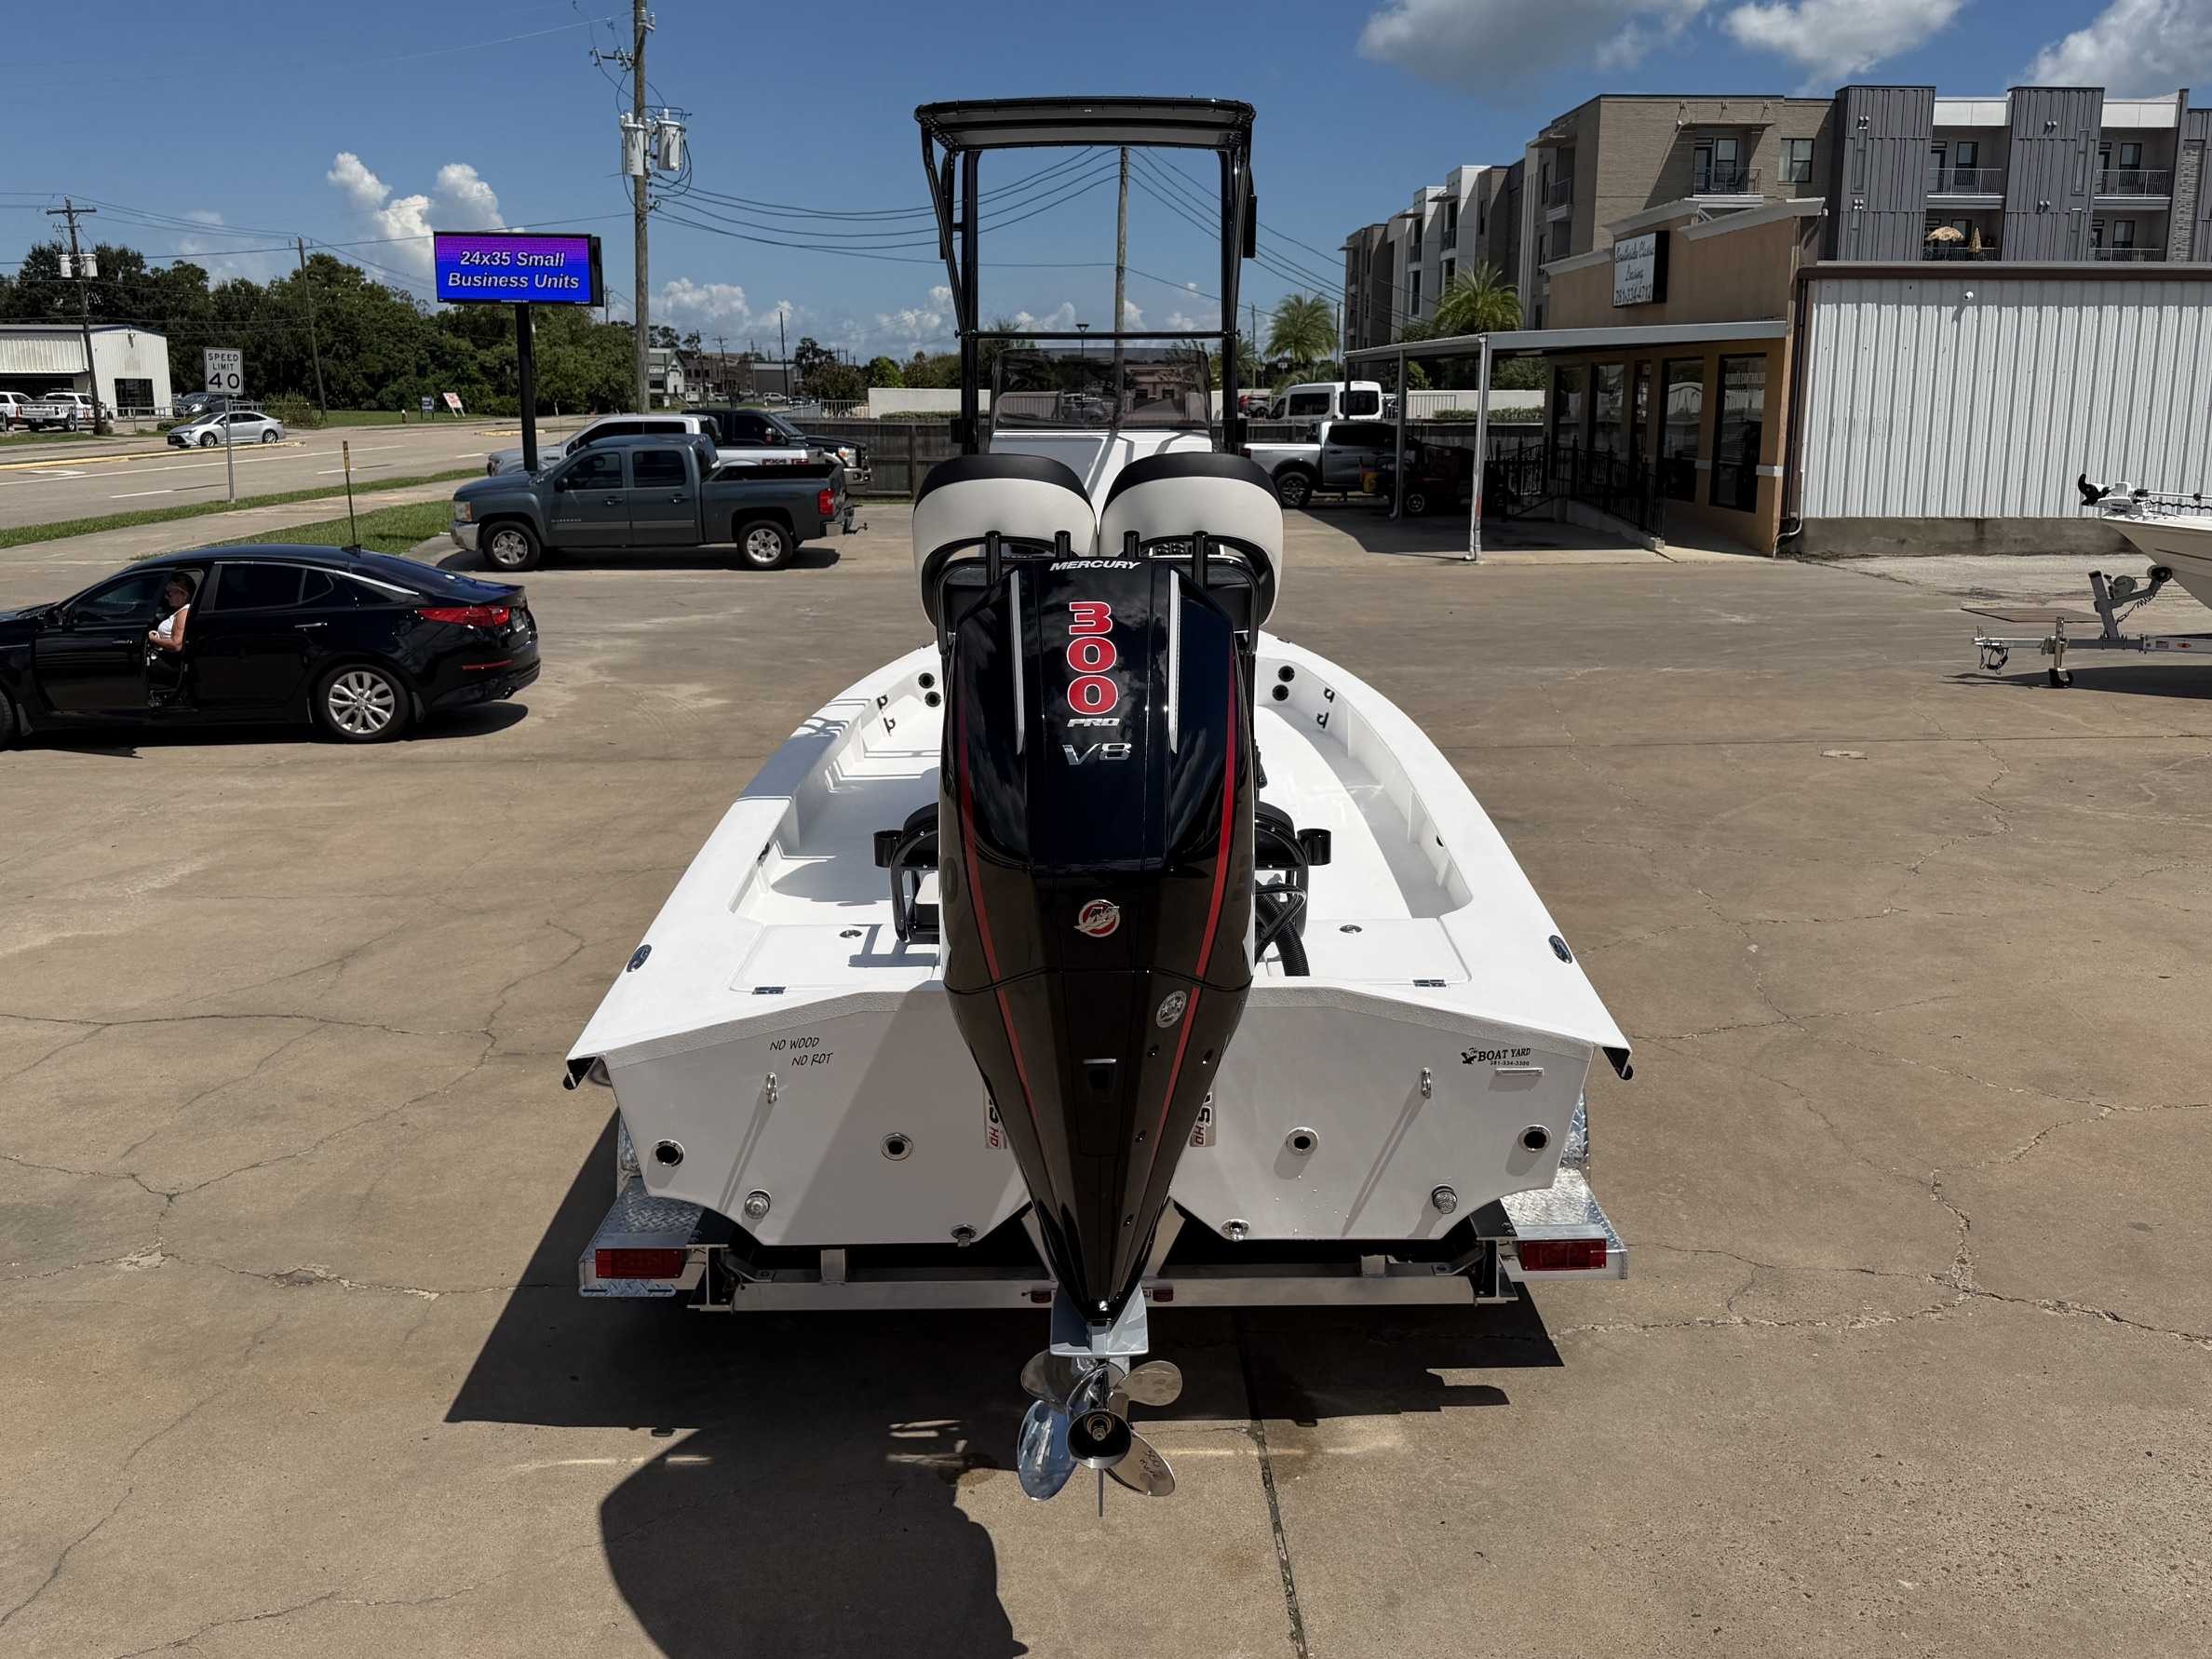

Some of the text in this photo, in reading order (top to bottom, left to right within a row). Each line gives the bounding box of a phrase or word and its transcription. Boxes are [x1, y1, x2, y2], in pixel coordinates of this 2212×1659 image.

[460, 250, 565, 267] 24x35 Small
[448, 272, 579, 290] Business Units
[208, 352, 239, 362] SPEED
[208, 372, 240, 389] 40
[1049, 560, 1141, 572] MERCURY
[1066, 601, 1118, 715] 300
[1067, 718, 1120, 727] PRO
[1062, 743, 1132, 765] V8
[769, 1036, 819, 1050] NO WOOD
[791, 1052, 833, 1066] NO ROT
[1477, 1049, 1508, 1062] BOAT
[1510, 1047, 1531, 1058] YARD
